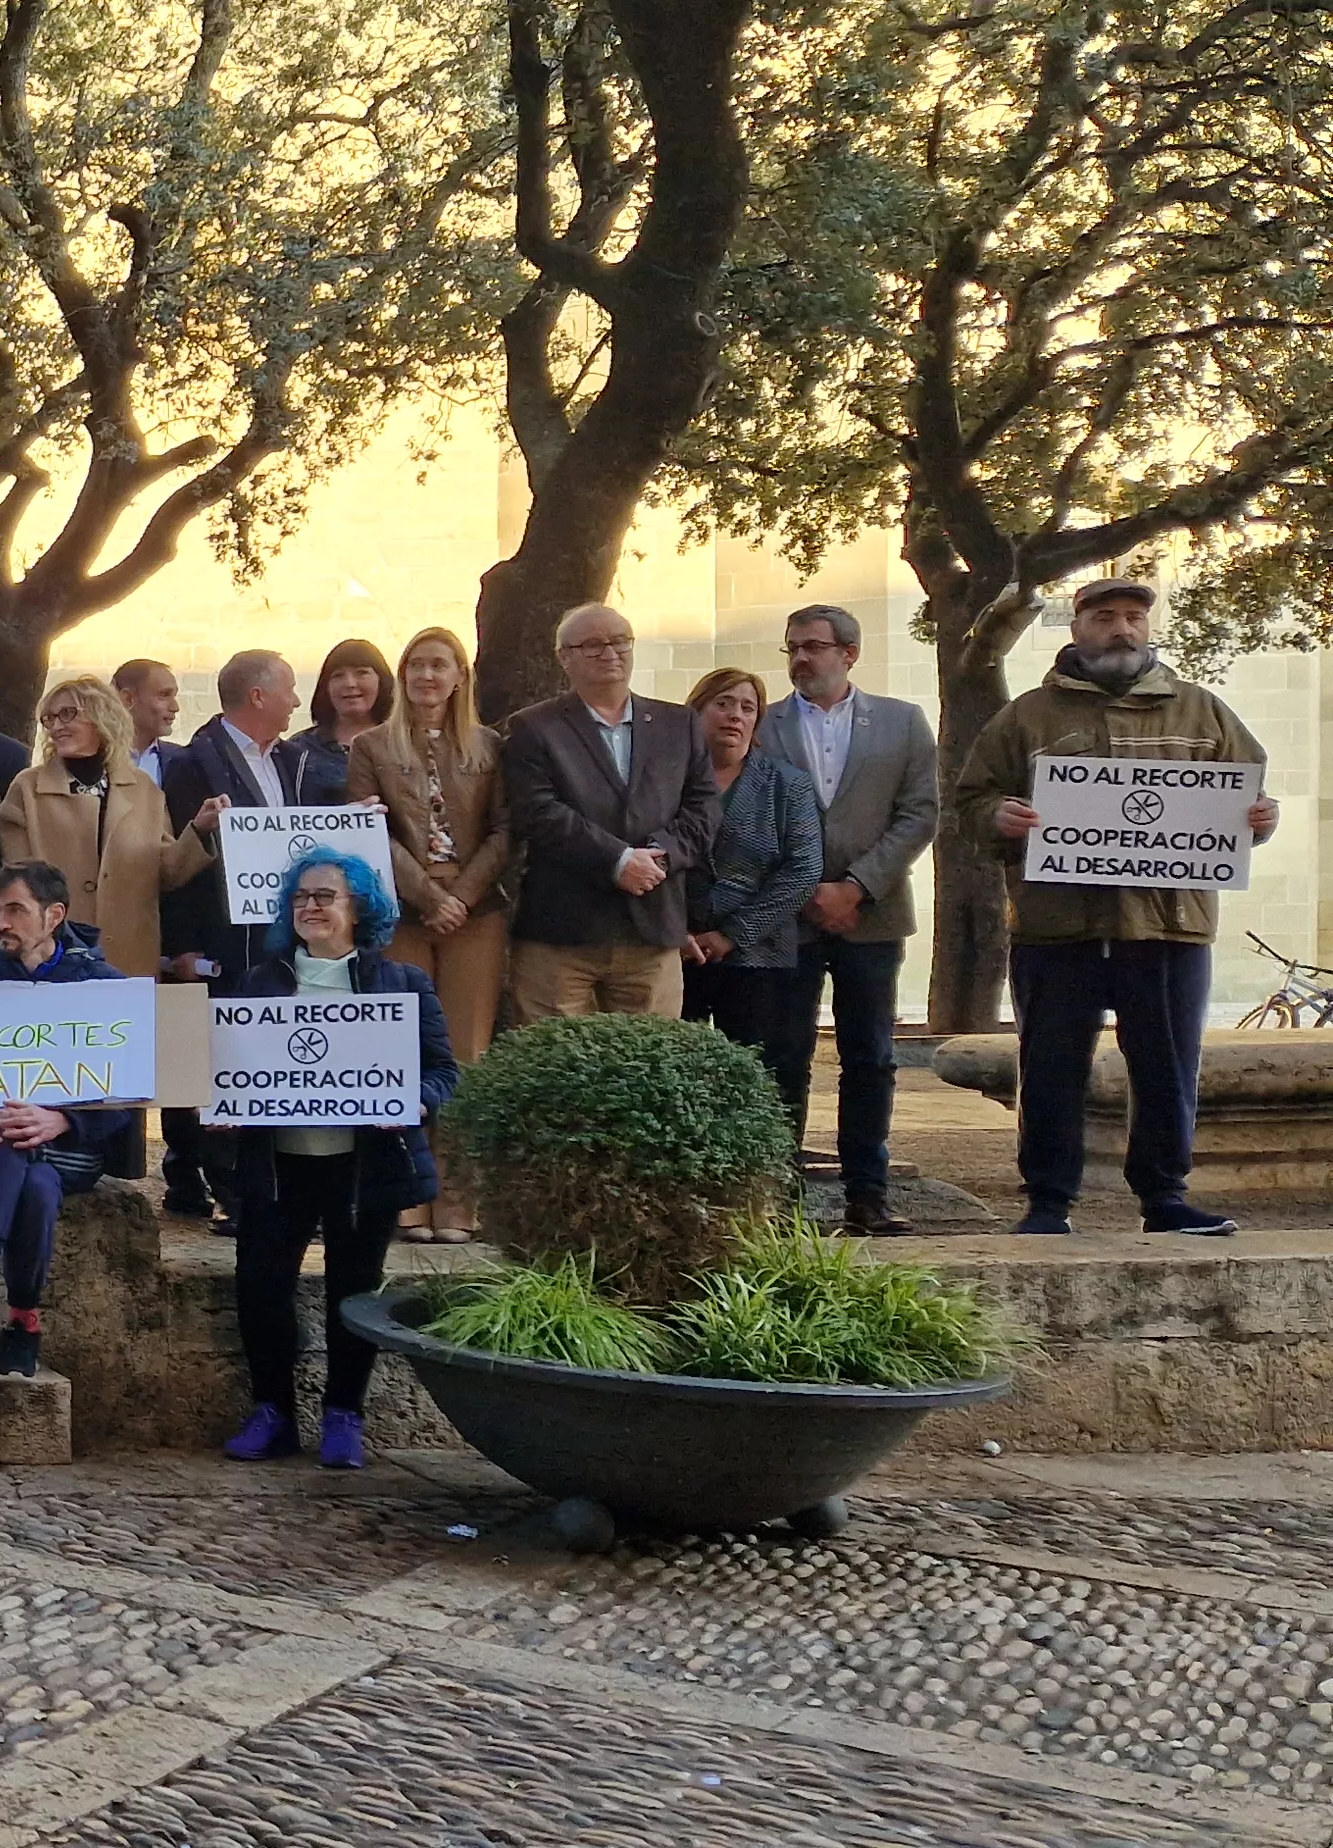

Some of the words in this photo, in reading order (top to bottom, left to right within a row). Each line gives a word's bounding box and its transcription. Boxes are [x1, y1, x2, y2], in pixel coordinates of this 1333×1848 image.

[1048, 764, 1089, 784] NO
[1093, 766, 1124, 785] AL
[1131, 768, 1245, 790] RECORTE
[230, 815, 259, 832] NO
[263, 815, 286, 832] AL
[290, 812, 376, 832] RECORTE
[1042, 826, 1237, 852] COOPERACIÓN
[1039, 855, 1069, 874] AL
[1076, 856, 1234, 882] DESARROLLO
[242, 900, 264, 915] AL
[215, 1006, 253, 1026] NO
[258, 1005, 288, 1025] AL
[294, 1002, 403, 1024] RECORTE
[214, 1063, 405, 1089] COOPERACIÓN
[214, 1098, 243, 1117] AL
[248, 1098, 405, 1117] DESARROLLO
